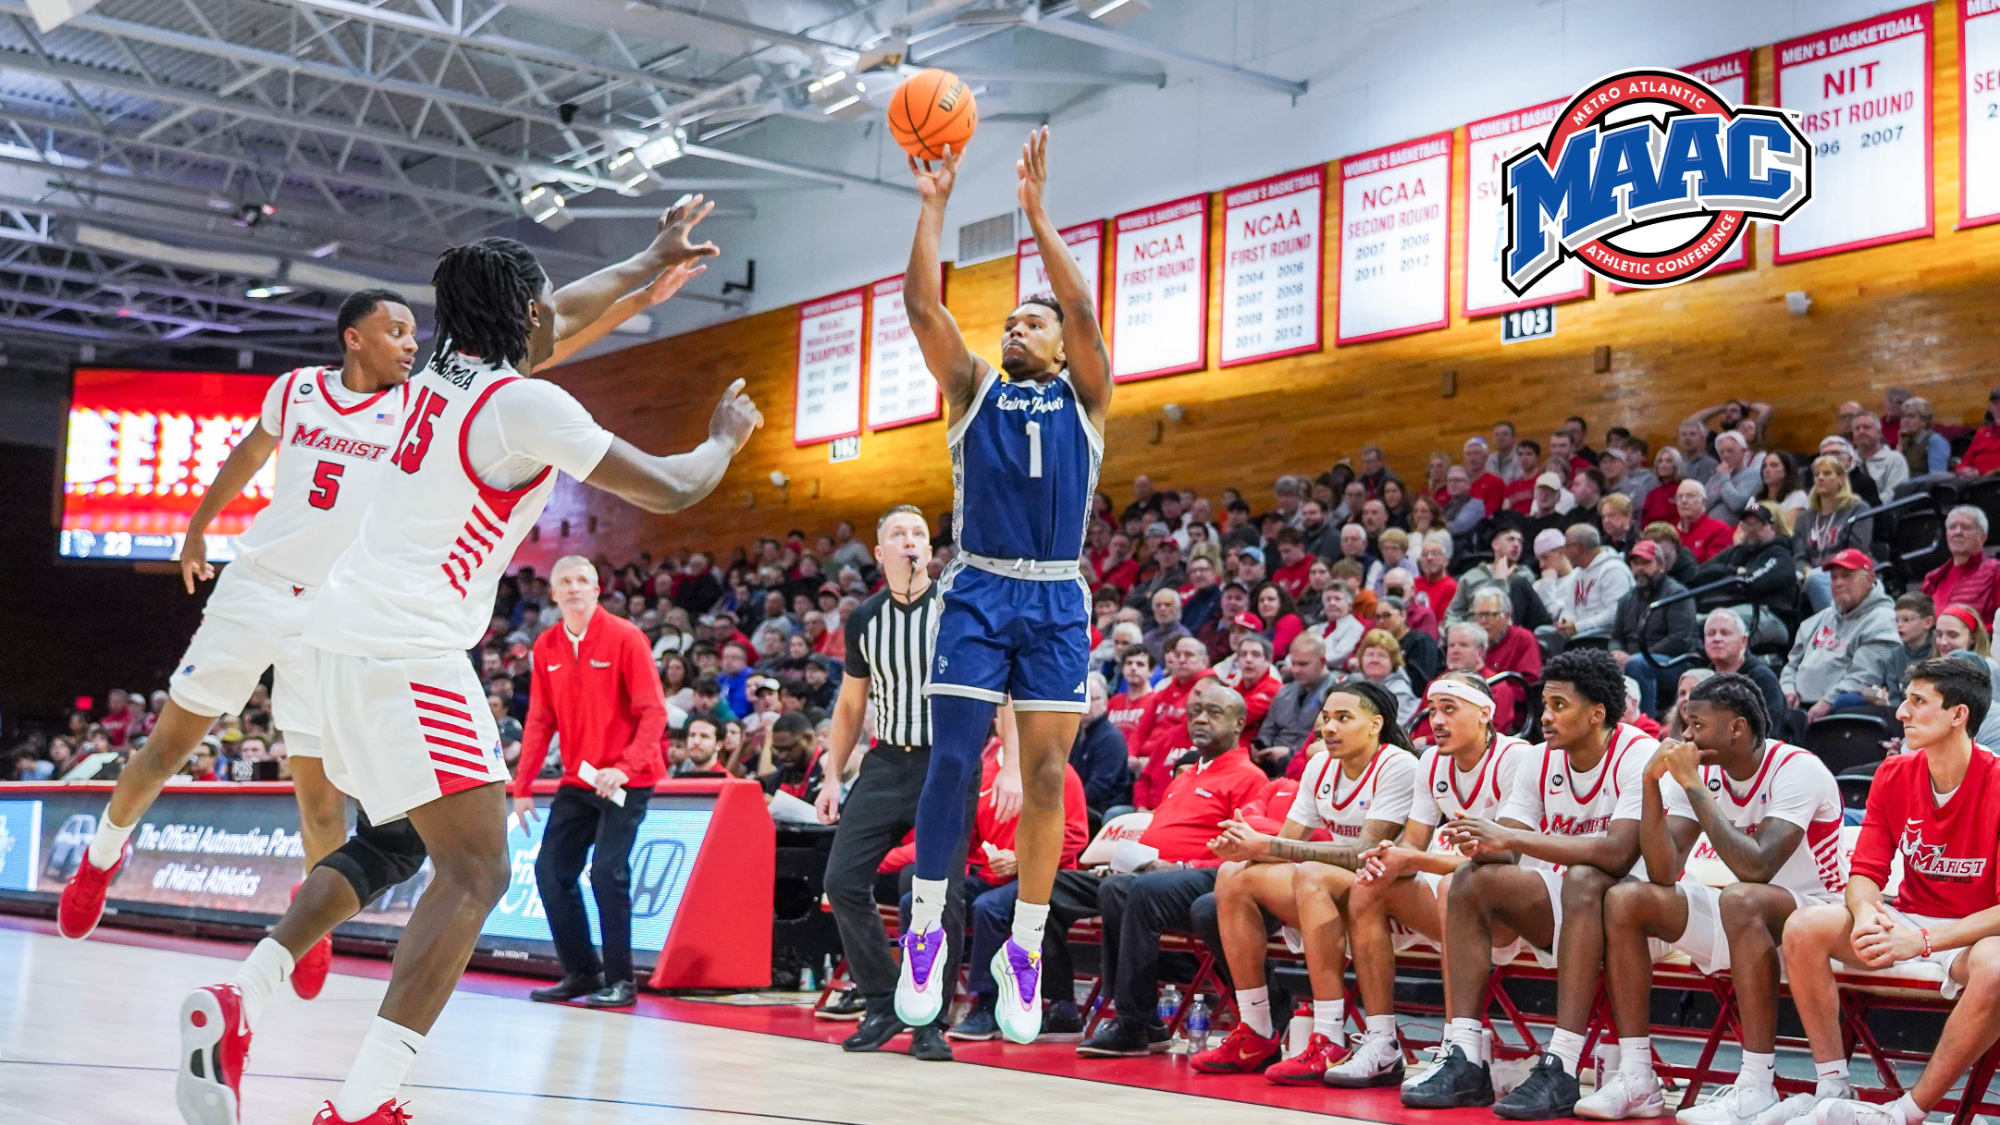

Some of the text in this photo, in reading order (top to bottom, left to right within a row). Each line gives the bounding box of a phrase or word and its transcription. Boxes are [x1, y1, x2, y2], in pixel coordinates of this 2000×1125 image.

[1782, 14, 1924, 66] MEN'S BASKETBALL
[1823, 61, 1880, 99] NIT
[1470, 114, 1520, 141] WOMEN'S
[1801, 91, 1914, 134] IRST ROUND
[1860, 125, 1905, 150] 2007
[1343, 137, 1448, 178] WOMEN'S BASKETBALL
[1362, 177, 1426, 211] NCAA
[1243, 209, 1301, 239] NCAA
[1347, 203, 1440, 240] SECOND ROUND
[1134, 233, 1184, 262] NCAA
[1231, 233, 1311, 267] FIRST ROUND
[1355, 242, 1386, 260] 2007
[1123, 257, 1195, 288] FIRST ROUND
[1355, 254, 1430, 282] 2011 2012
[1509, 308, 1549, 338] 103
[290, 423, 391, 462] MARIST
[391, 386, 448, 475] 15
[1026, 420, 1043, 478] 1
[308, 460, 346, 511] 5
[233, 760, 254, 776] POSS
[136, 823, 160, 850] The
[158, 824, 204, 853] Official
[199, 826, 269, 856] Automotive
[153, 863, 261, 896] of Marist Athletics
[1909, 851, 1987, 877] MARIST
[1924, 873, 1973, 884] BASKETBALL
